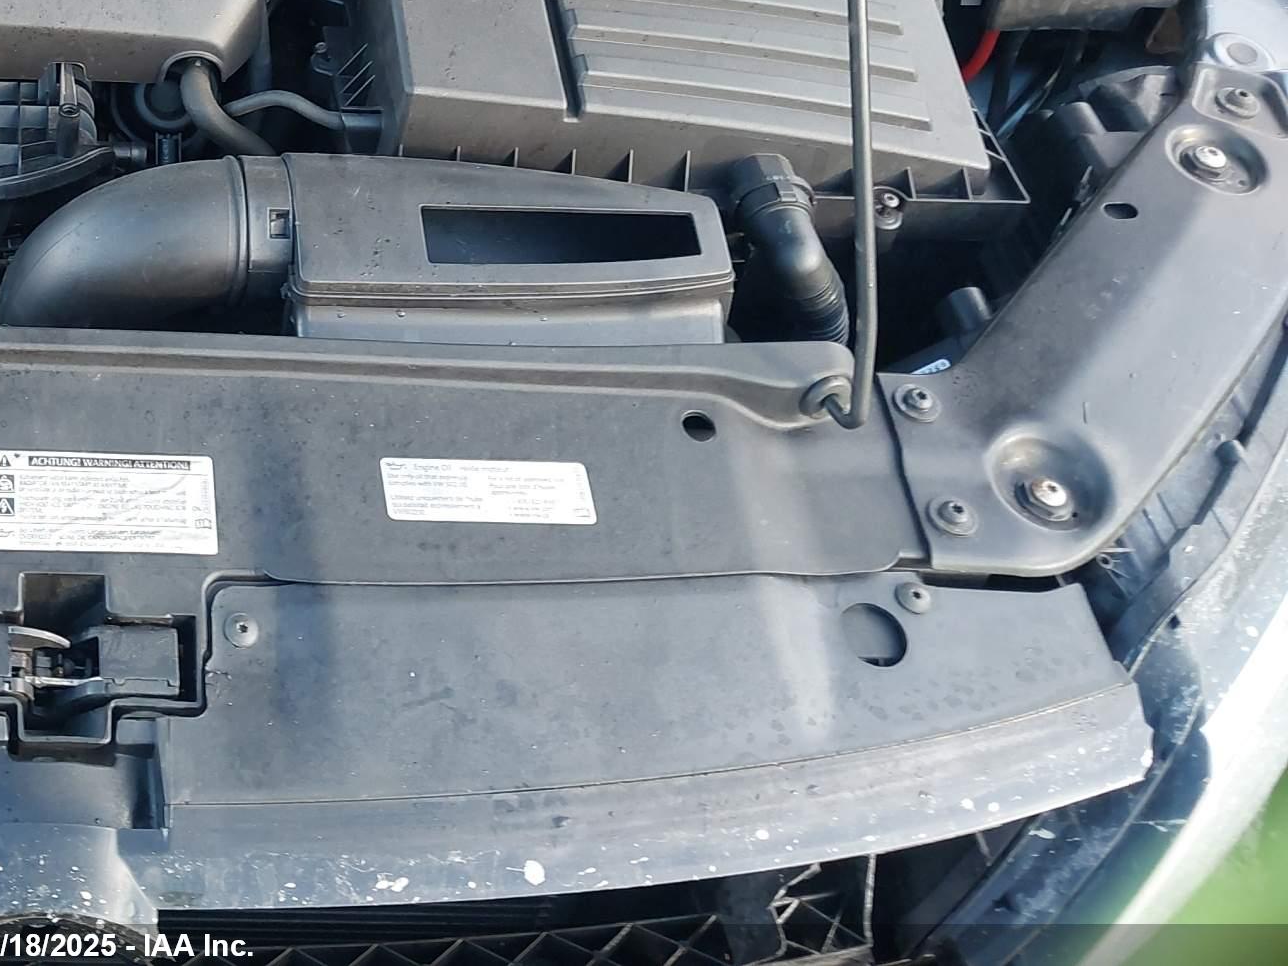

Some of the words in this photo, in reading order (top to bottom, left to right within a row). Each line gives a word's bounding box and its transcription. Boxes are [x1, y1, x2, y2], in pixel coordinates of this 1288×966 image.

[31, 456, 81, 466] ACHTUNG!
[82, 458, 132, 468] WARNING!
[133, 460, 189, 470] ATTENTION!
